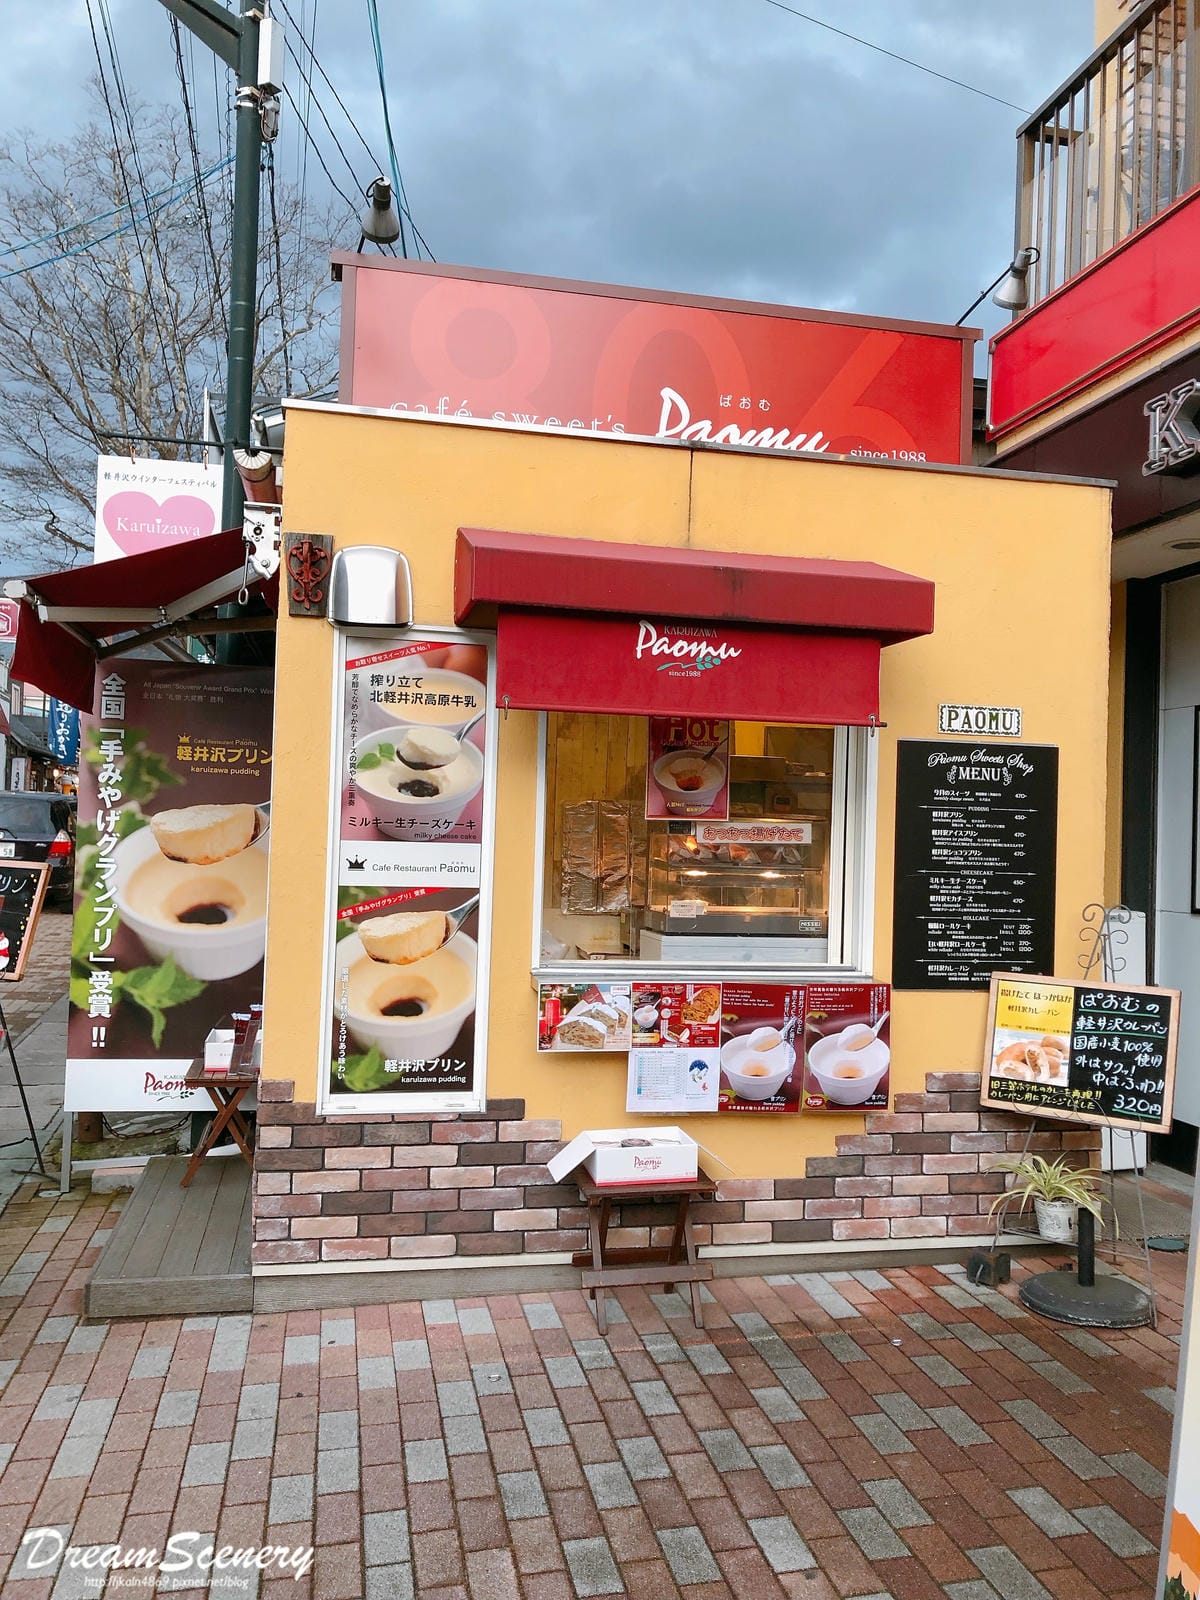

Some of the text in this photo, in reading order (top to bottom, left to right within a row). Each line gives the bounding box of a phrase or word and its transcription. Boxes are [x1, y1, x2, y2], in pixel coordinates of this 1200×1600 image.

[719, 394, 771, 412] ぱおむ
[116, 517, 201, 537] Karuizawa
[635, 620, 742, 659] Paomu
[664, 625, 718, 638] KARUIZAWA
[370, 673, 424, 689] 搾り立て
[369, 689, 477, 708] 北軽井沢高原牛乳
[947, 709, 1013, 731] PAOMU
[177, 745, 272, 765] 軽井沢プリン
[190, 765, 260, 777] karuizawa pudding
[958, 766, 1001, 781] MENU
[348, 816, 477, 830] ミルキー生チーズケーキ
[372, 863, 476, 873] Cafe Restaurant Paomu
[0, 874, 28, 893] リン
[1076, 1015, 1168, 1034] 軽井沢カレーパン
[384, 1057, 467, 1073] 軽井沢プリン
[1134, 1053, 1163, 1068] 使用
[143, 1071, 199, 1094] Paom
[438, 1075, 467, 1083] pudding
[1113, 1094, 1162, 1115] 320円
